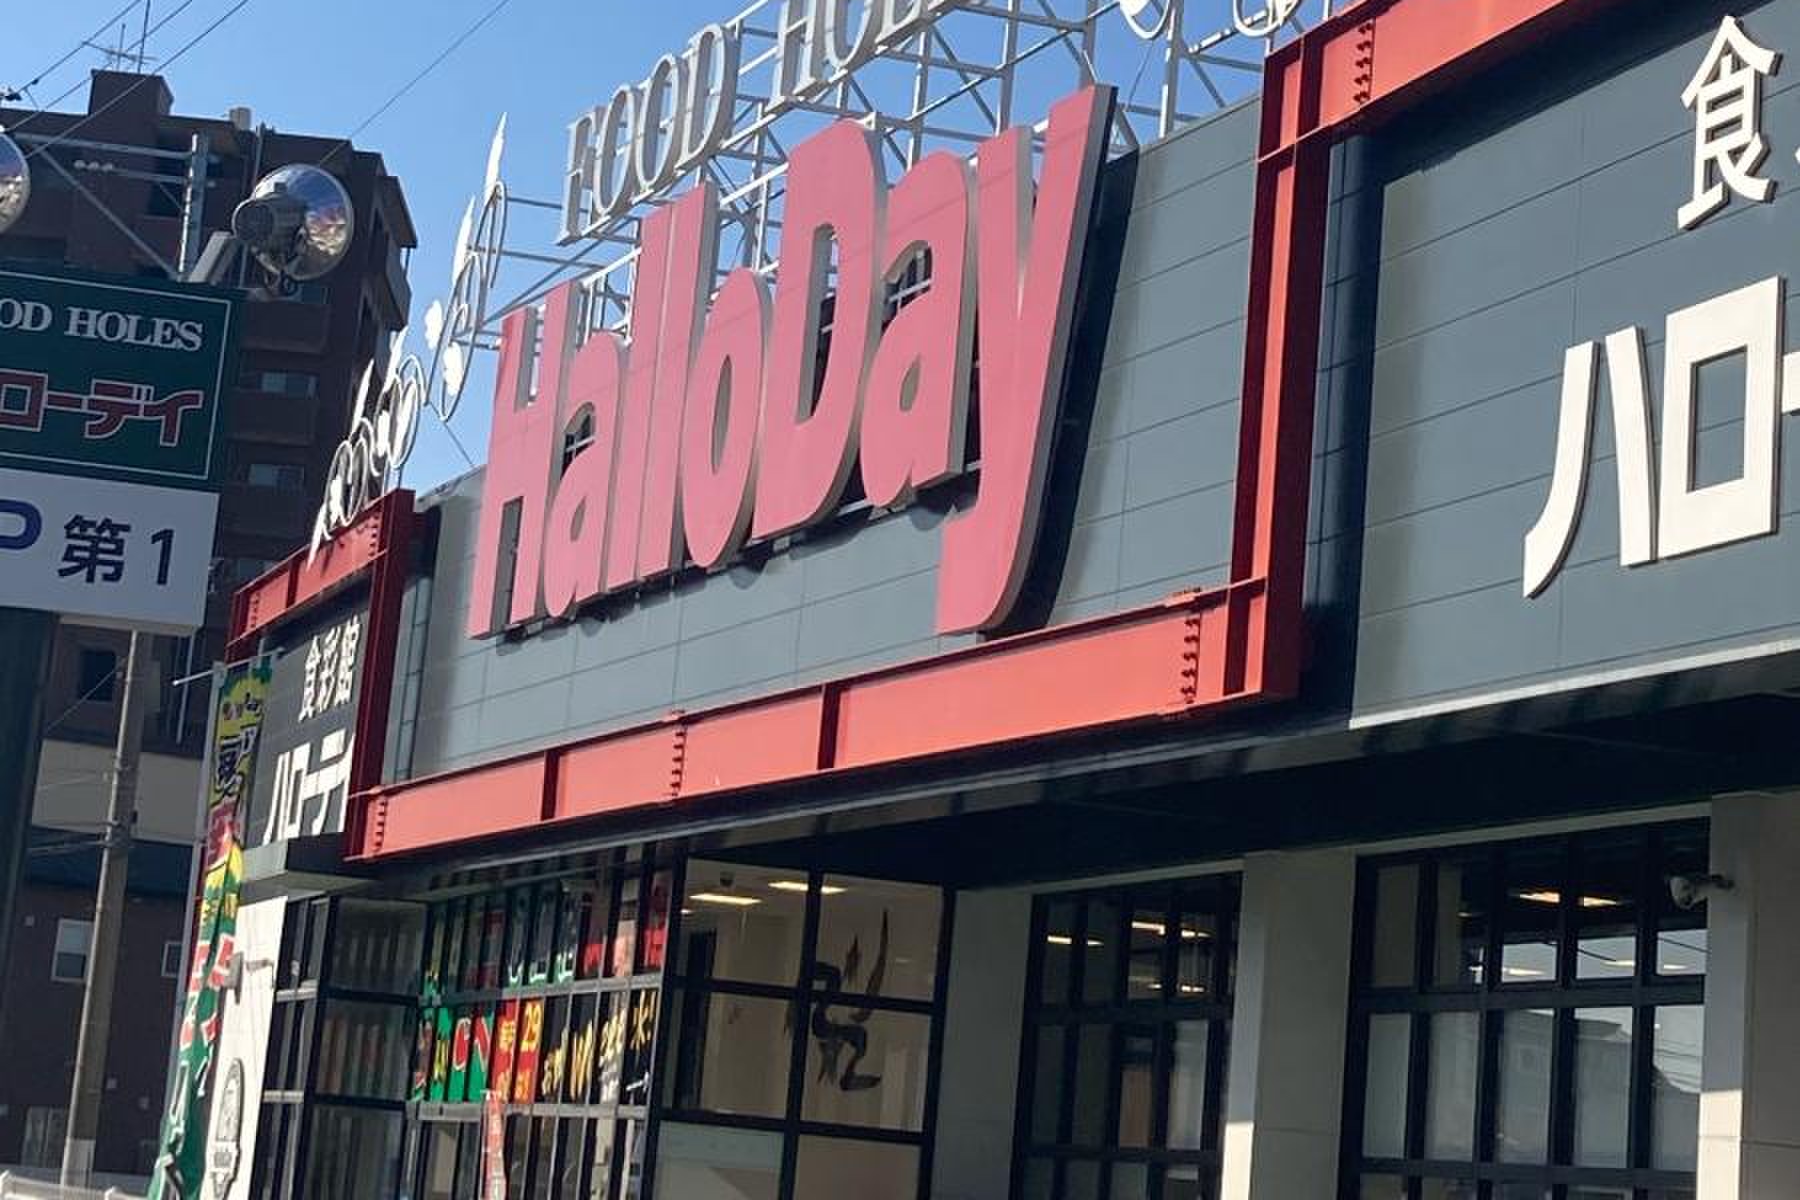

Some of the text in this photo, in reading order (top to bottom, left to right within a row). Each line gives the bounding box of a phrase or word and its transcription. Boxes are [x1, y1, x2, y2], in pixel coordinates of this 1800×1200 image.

[557, 21, 738, 245] FOOD
[1678, 16, 1800, 231] 食
[64, 306, 204, 352] HOLES
[467, 83, 1118, 640] HalloDay
[1523, 275, 1800, 600] ハロ
